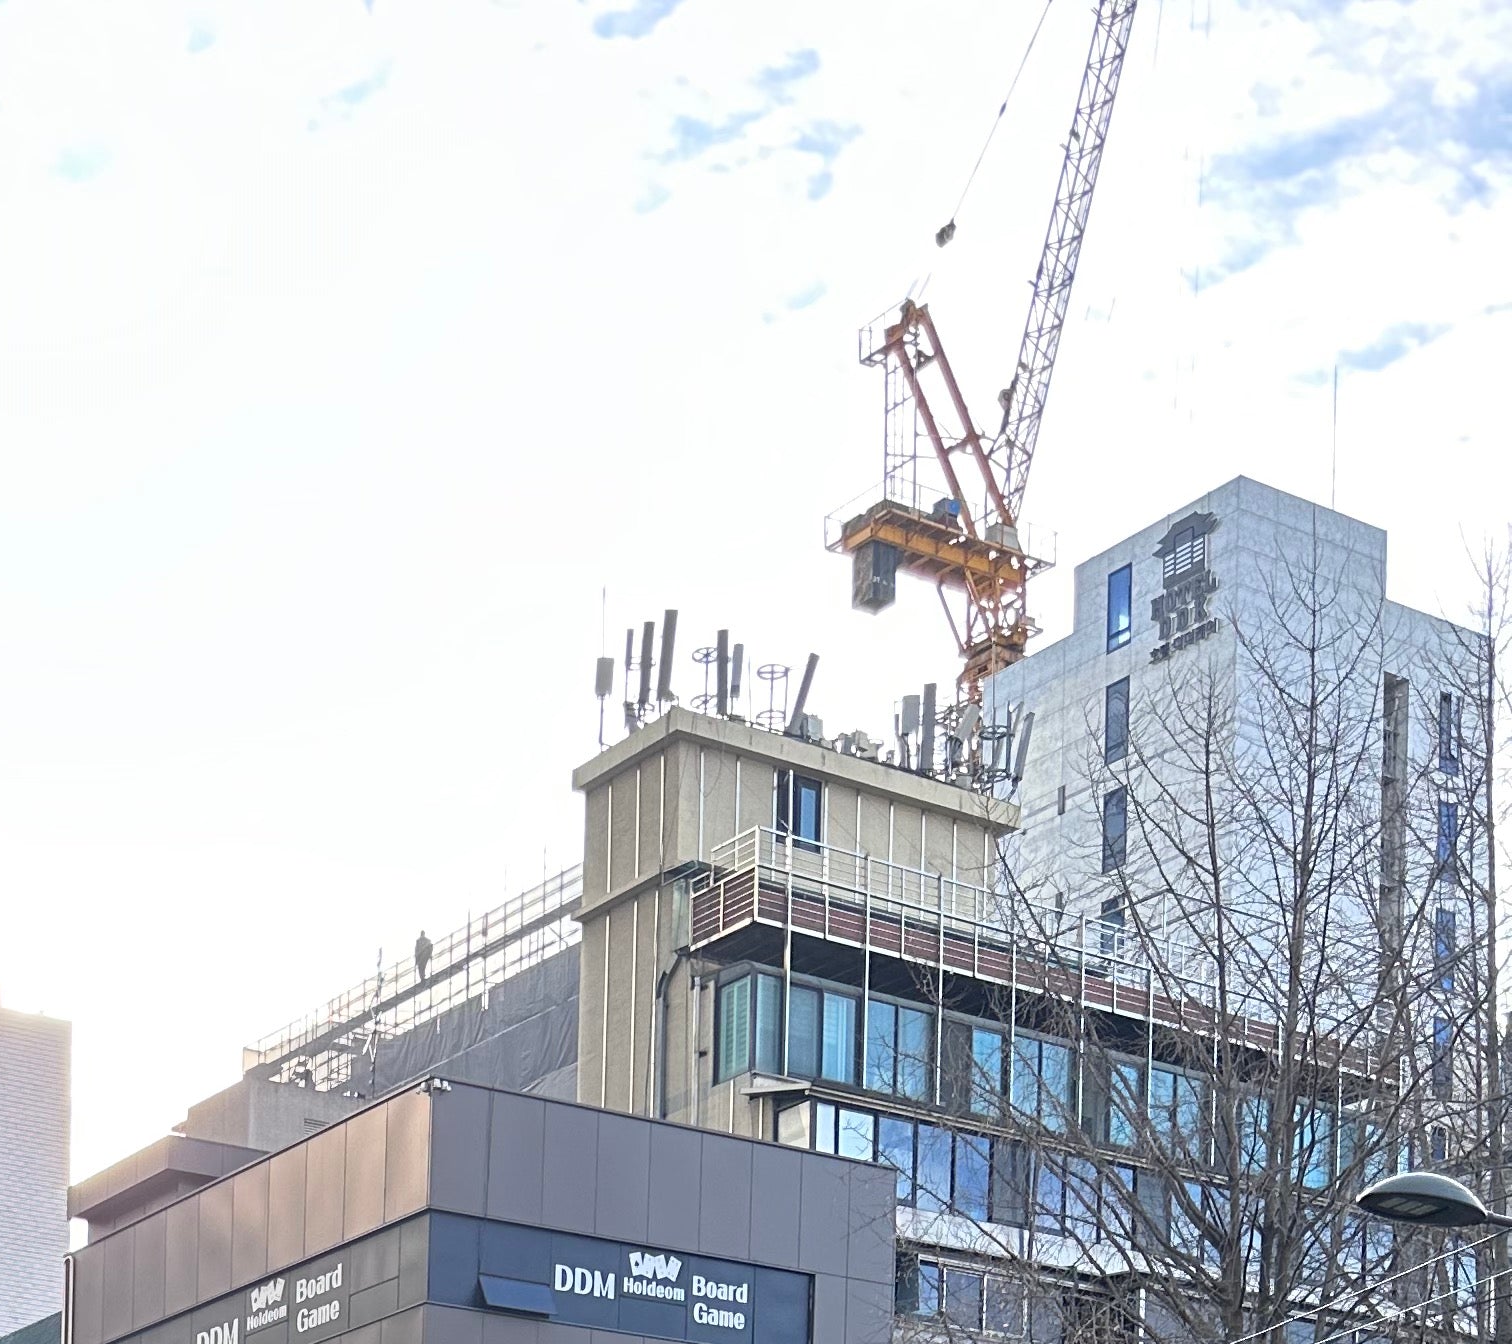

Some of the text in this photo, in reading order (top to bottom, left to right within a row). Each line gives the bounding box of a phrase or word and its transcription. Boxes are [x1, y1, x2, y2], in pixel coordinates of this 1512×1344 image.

[247, 1304, 287, 1331] Holdeom
[296, 1263, 342, 1304] Board
[554, 1264, 748, 1304] DDM Holdeom Board
[297, 1300, 339, 1333] Game
[693, 1302, 745, 1330] Game
